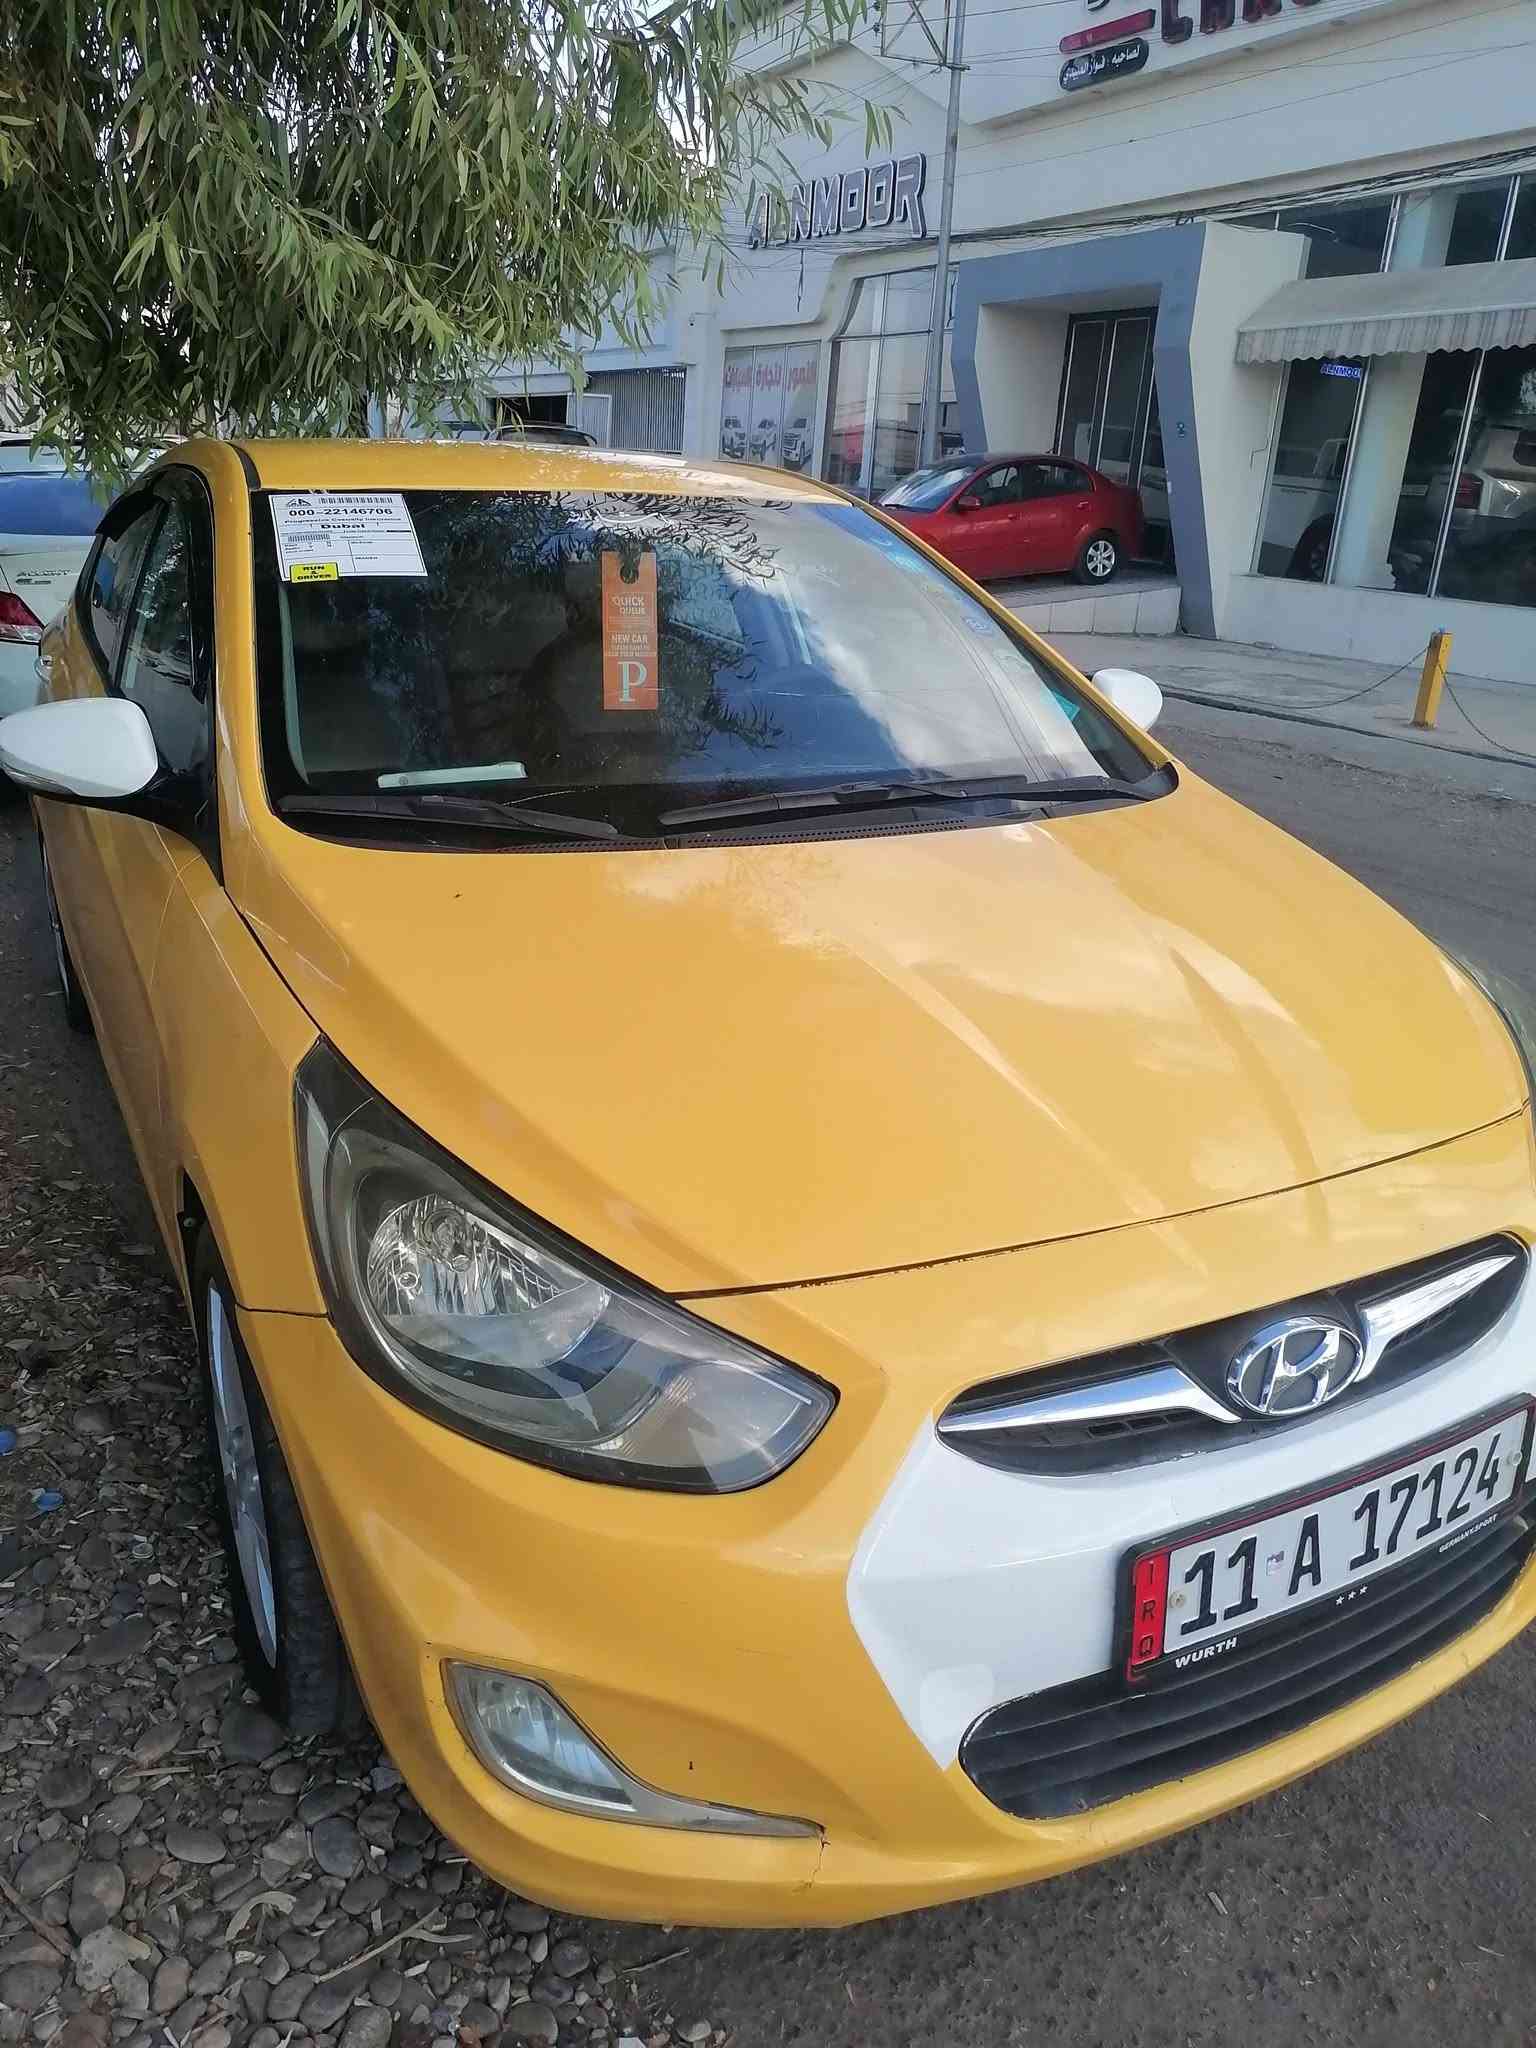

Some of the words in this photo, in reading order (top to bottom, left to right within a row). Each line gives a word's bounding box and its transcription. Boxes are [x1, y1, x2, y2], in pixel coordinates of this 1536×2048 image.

[617, 661, 648, 704] P
[1181, 1536, 1258, 1636] 11
[1288, 1514, 1322, 1596] A
[1350, 1433, 1501, 1571] 17124
[1175, 1637, 1238, 1669] WURTH
